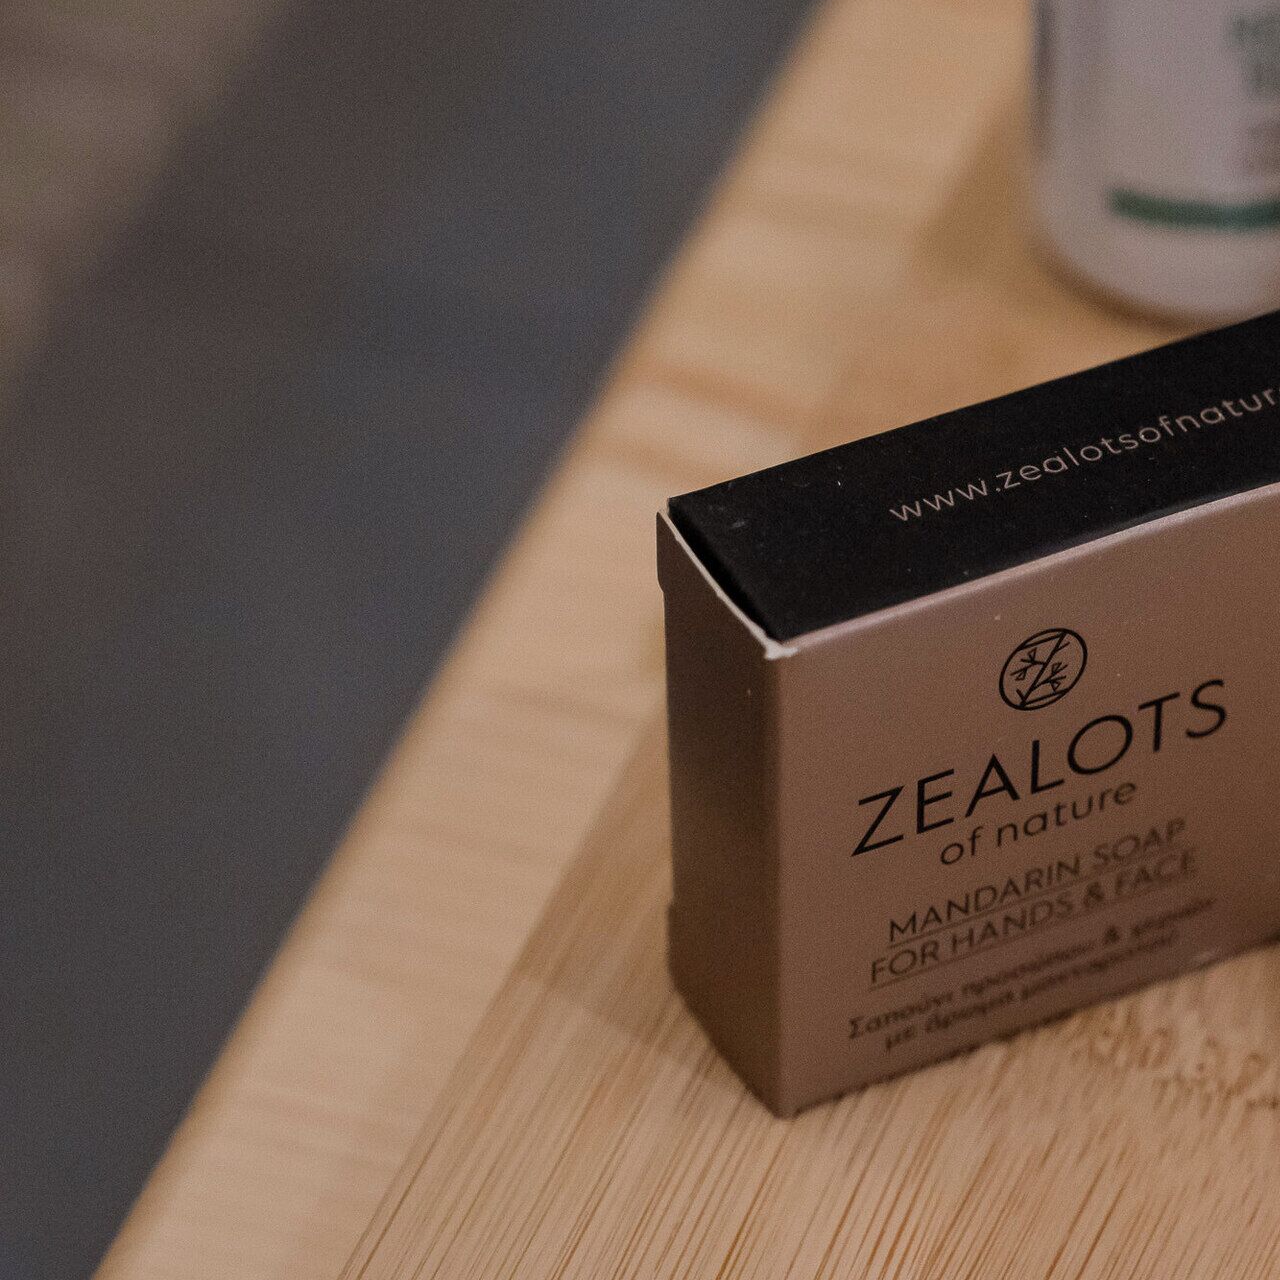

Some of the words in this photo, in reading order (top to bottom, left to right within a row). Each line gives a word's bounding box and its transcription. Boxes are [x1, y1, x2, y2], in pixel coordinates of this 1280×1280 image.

[851, 678, 1227, 858] ZEALOTS
[939, 826, 985, 876] of
[996, 781, 1138, 848] nature
[871, 939, 941, 985] FOR
[951, 888, 1076, 956] HANDS
[1082, 881, 1106, 911] &
[1114, 845, 1198, 898] FACE
[888, 856, 1082, 943] MANDARIN
[1091, 817, 1187, 872] SOAP
